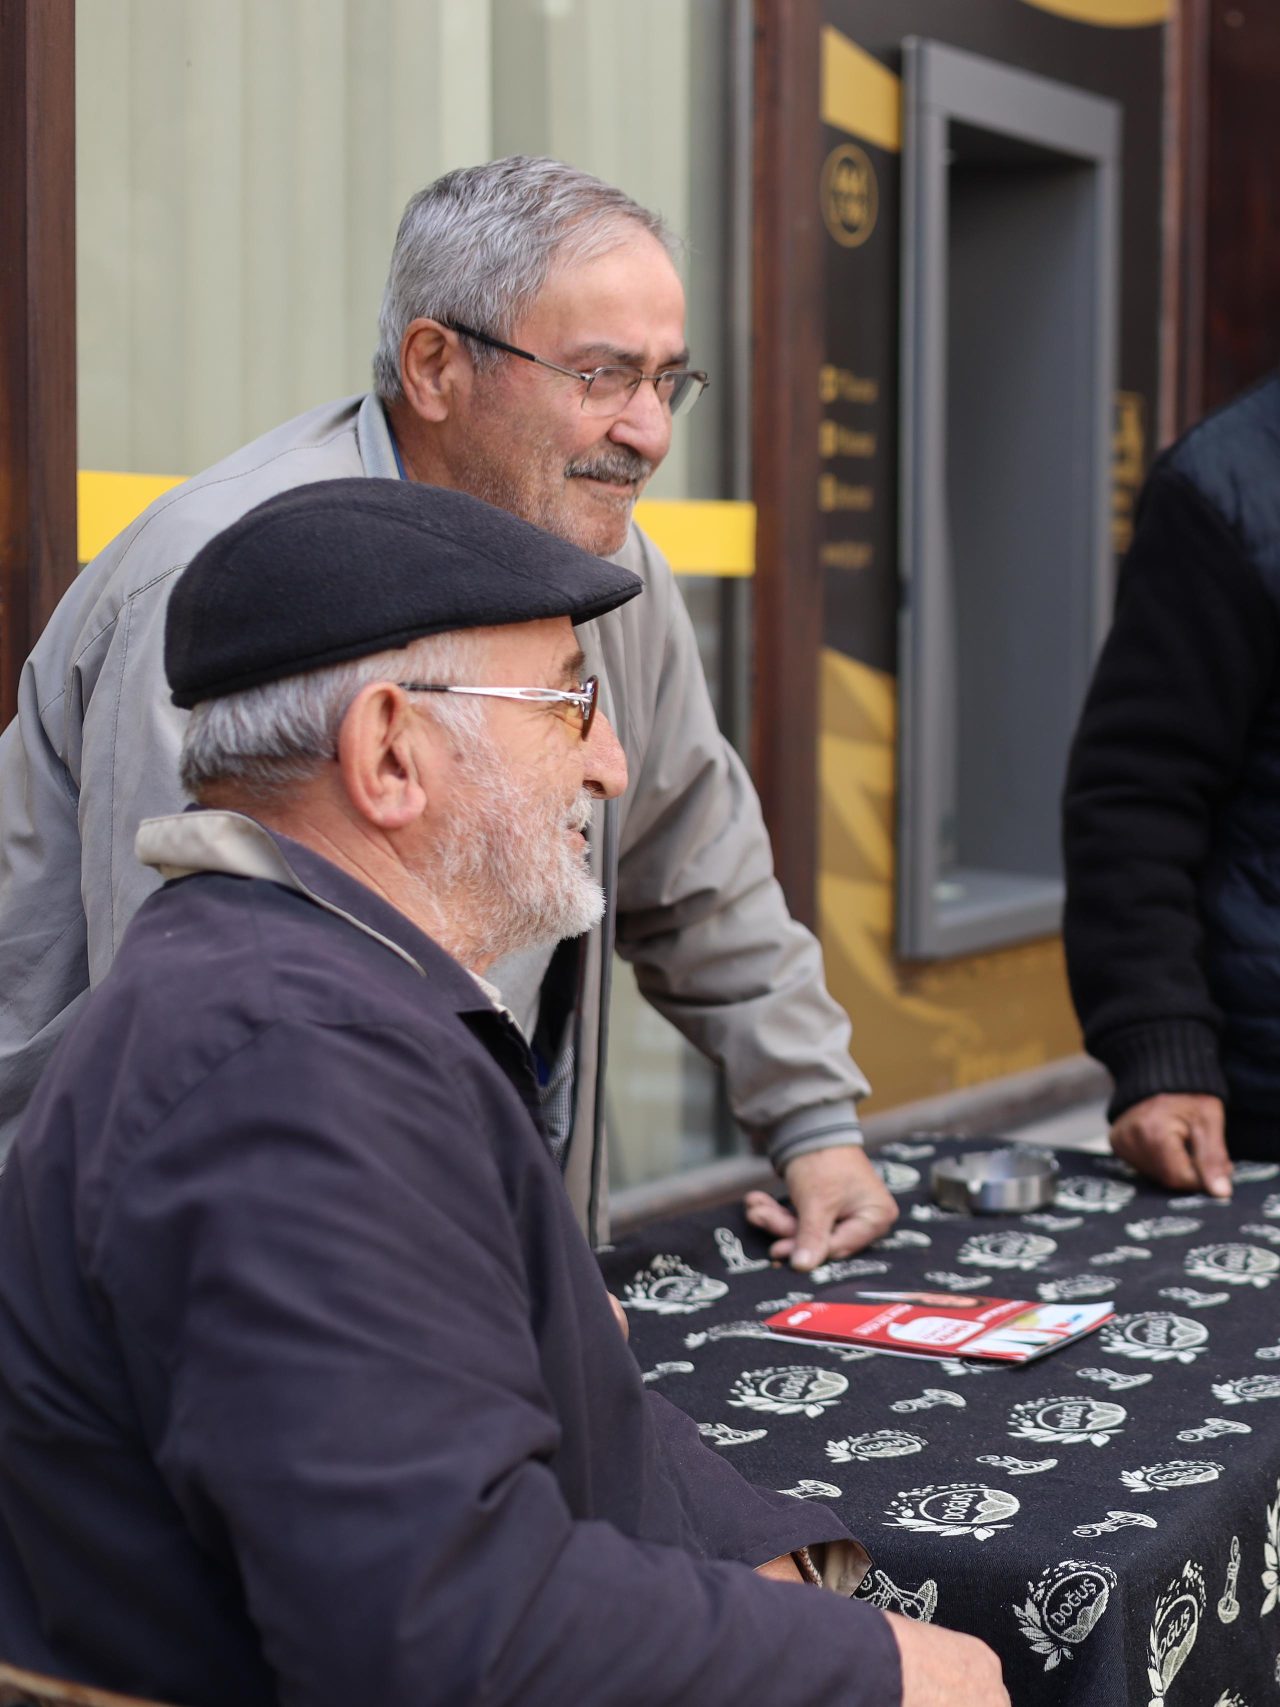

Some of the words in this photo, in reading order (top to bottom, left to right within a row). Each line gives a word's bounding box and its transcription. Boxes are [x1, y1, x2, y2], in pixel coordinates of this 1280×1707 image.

[941, 1493, 979, 1520] DOĞUŞ
[1050, 1578, 1097, 1627] DOĞUŞ
[1159, 1606, 1191, 1660] OĞUŞ
